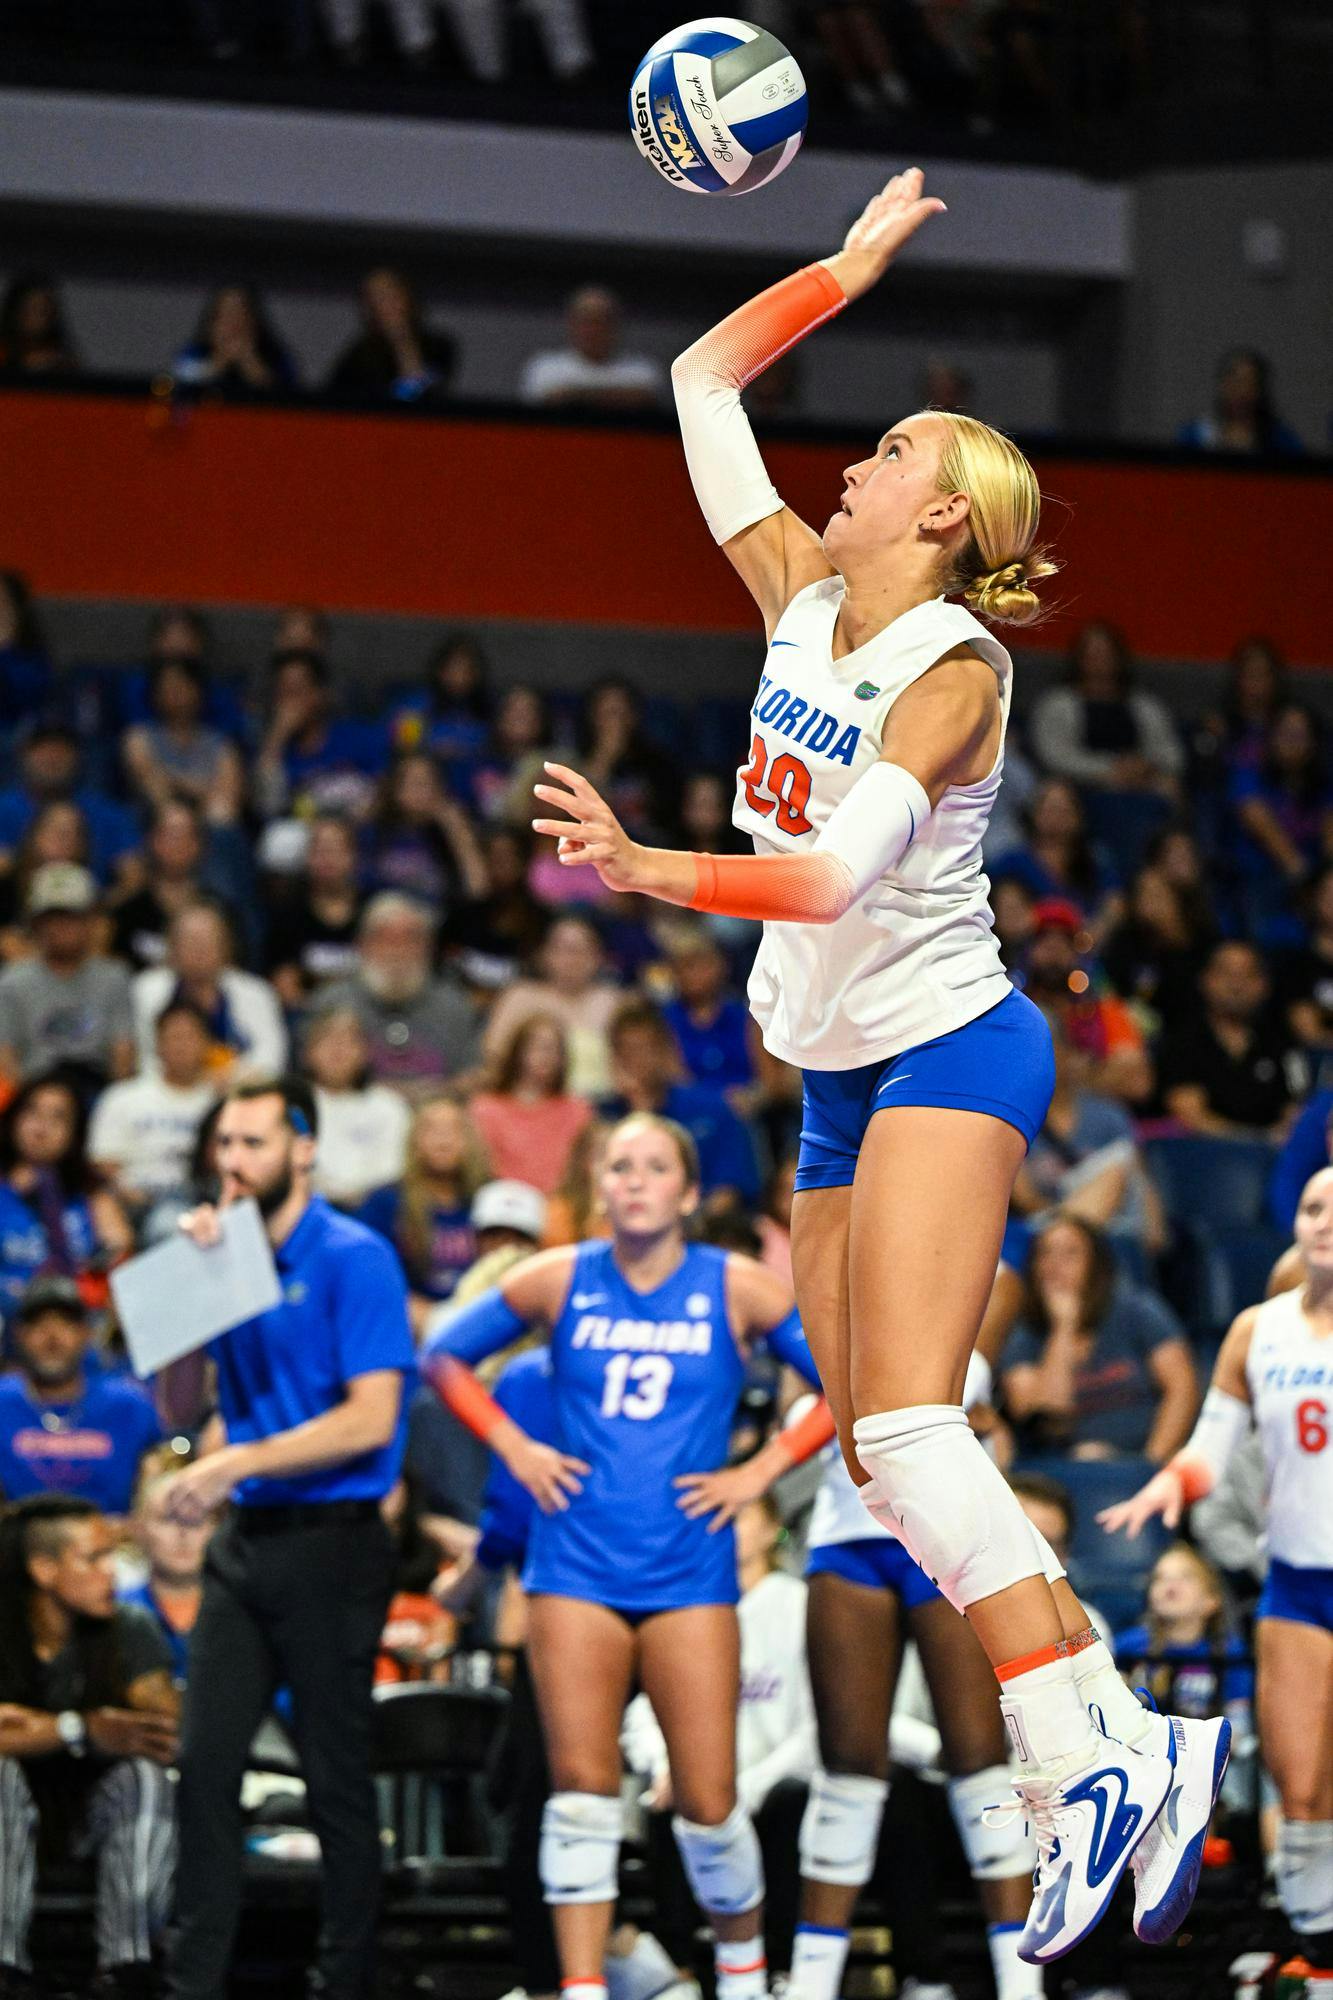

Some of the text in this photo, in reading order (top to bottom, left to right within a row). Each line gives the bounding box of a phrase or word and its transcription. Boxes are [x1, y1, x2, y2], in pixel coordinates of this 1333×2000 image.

[654, 95, 702, 169] NCAA
[686, 75, 712, 120] Touch
[636, 92, 684, 181] molten
[711, 124, 733, 162] Super
[753, 674, 861, 767] LORIDA
[740, 733, 813, 837] 20
[601, 1352, 675, 1421] 13
[1295, 1398, 1328, 1455] 6
